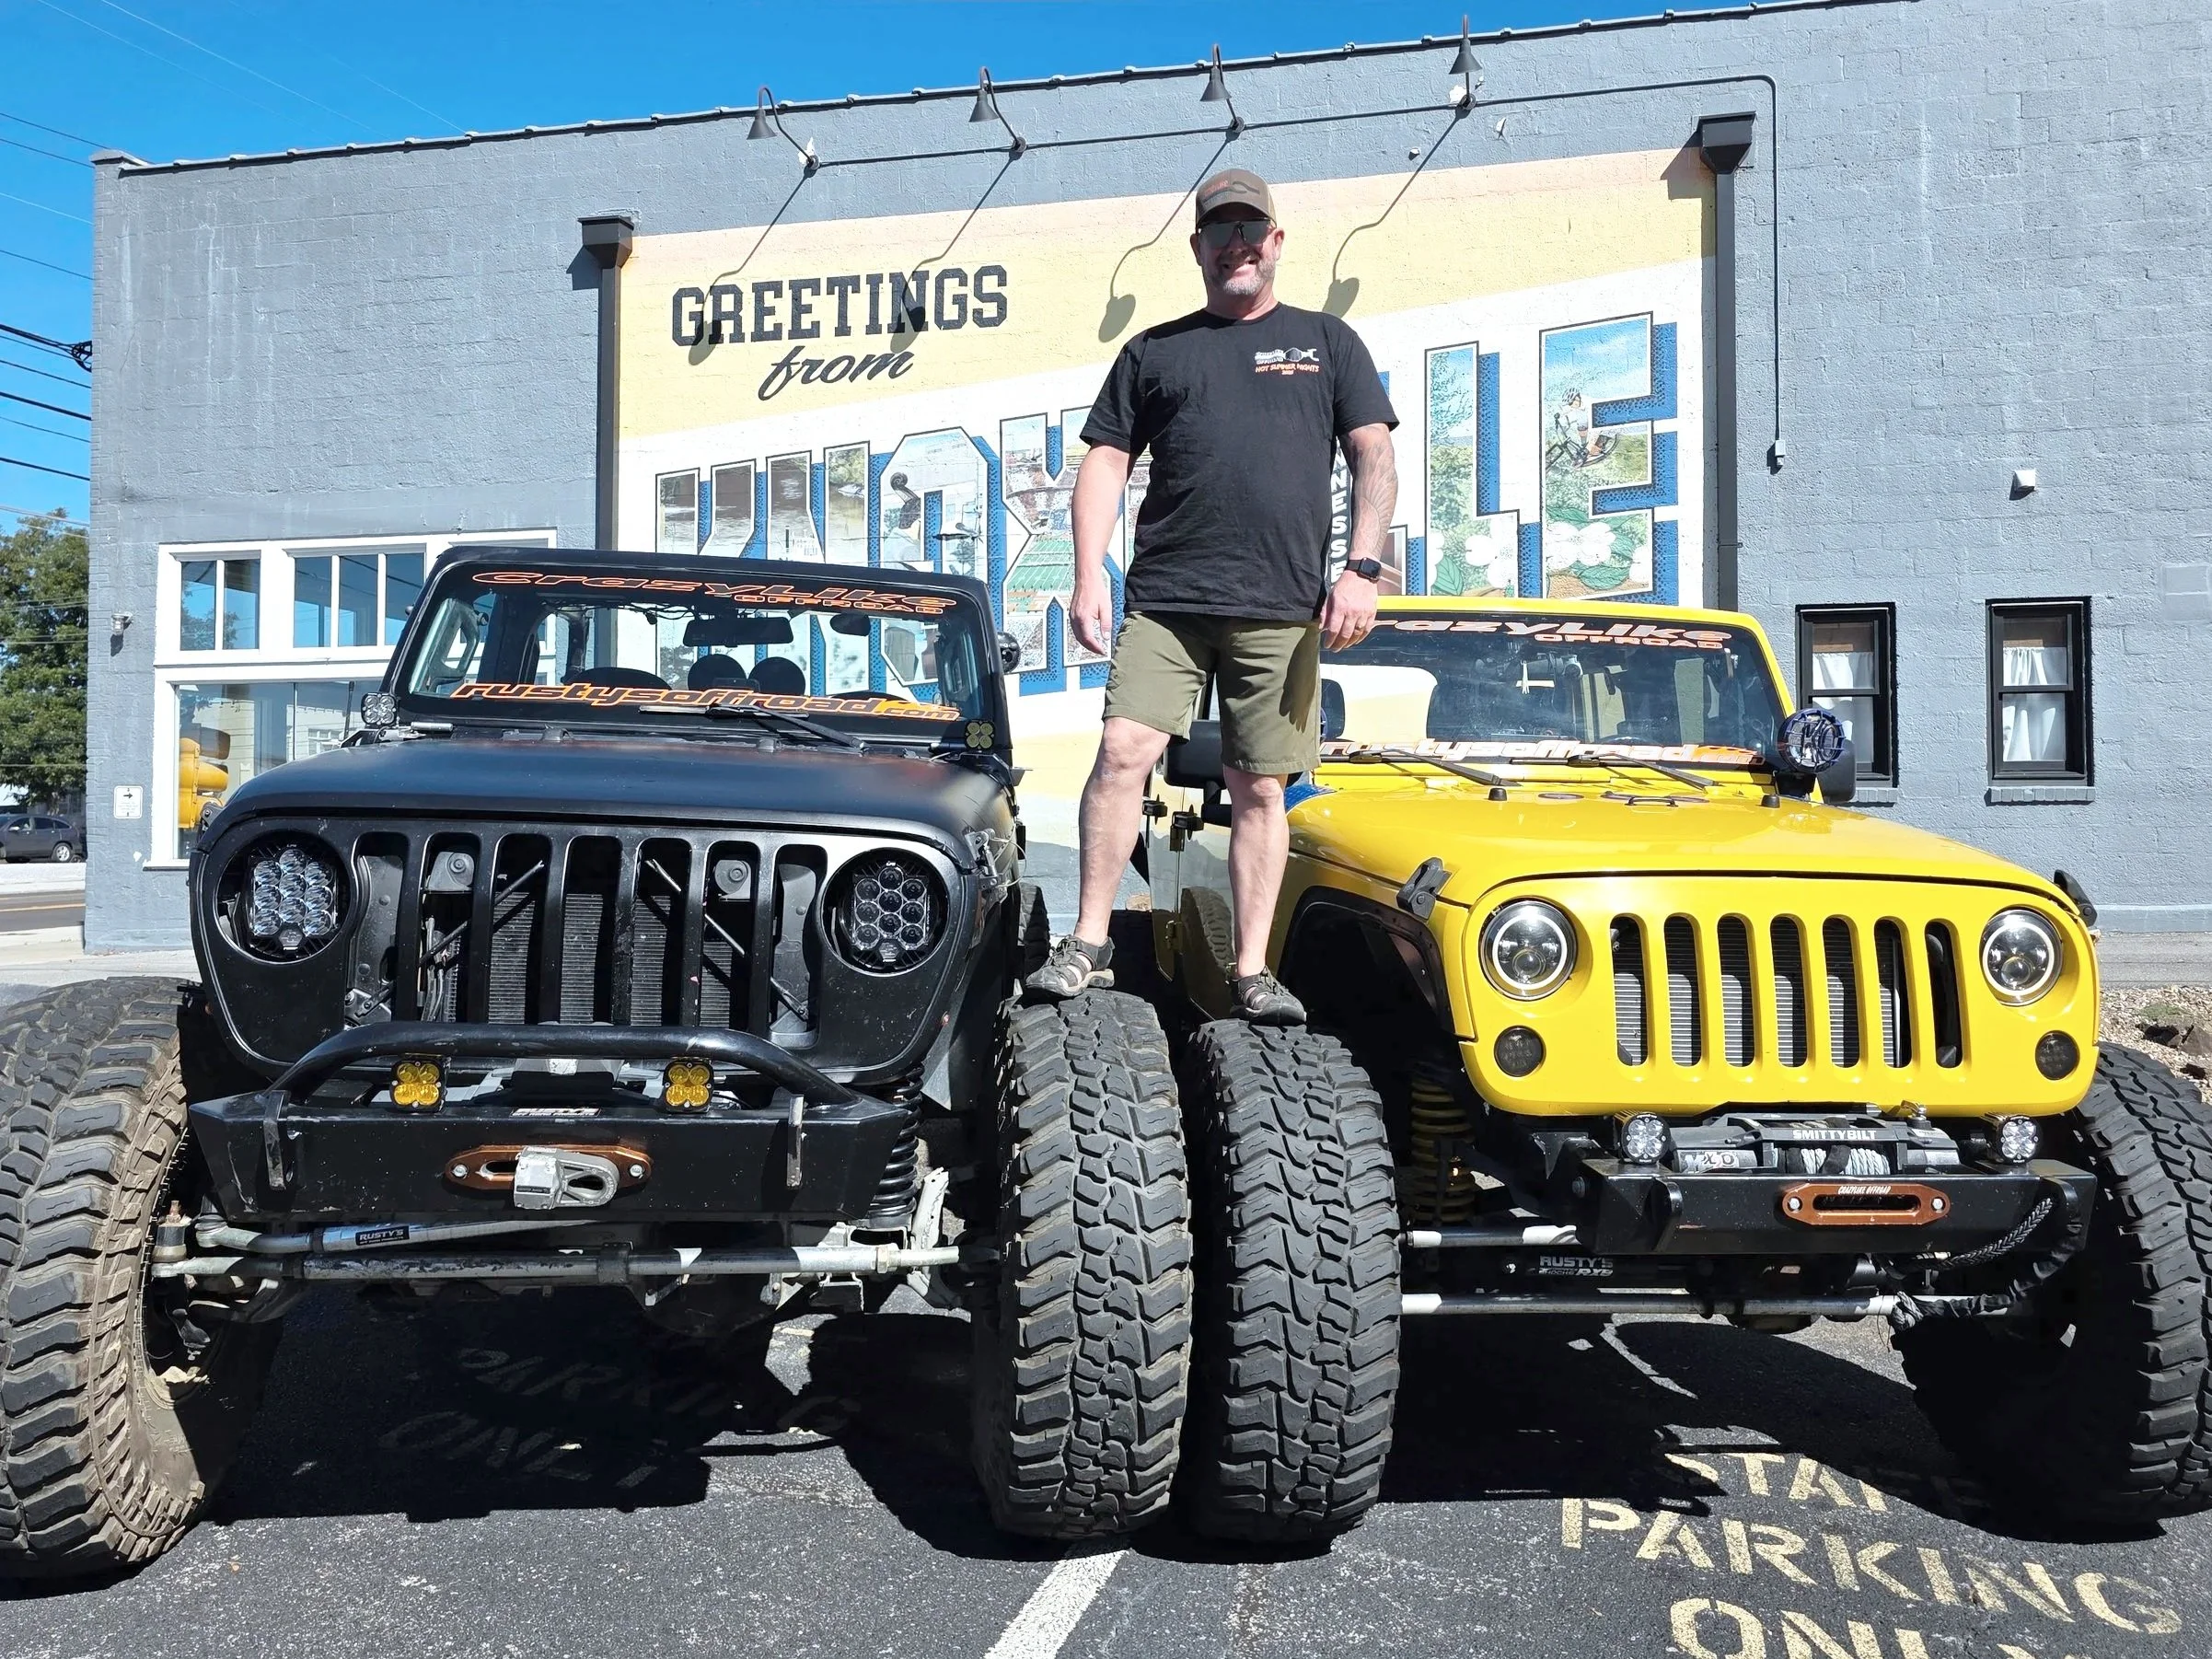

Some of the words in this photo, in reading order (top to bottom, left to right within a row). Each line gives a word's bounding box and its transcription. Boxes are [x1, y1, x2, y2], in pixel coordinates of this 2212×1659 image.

[672, 264, 1008, 347] GREETINGS
[758, 345, 913, 401] from
[734, 594, 944, 615] OFFROAD
[1535, 633, 1723, 650] OFFROAD
[449, 682, 961, 721] rustysoffroad.com
[1792, 1129, 1877, 1141] SMITTYBILT
[359, 1229, 404, 1241] RUSTY'S
[1538, 1255, 1614, 1269] RUSTY'S
[1560, 1497, 2183, 1636] PARKING
